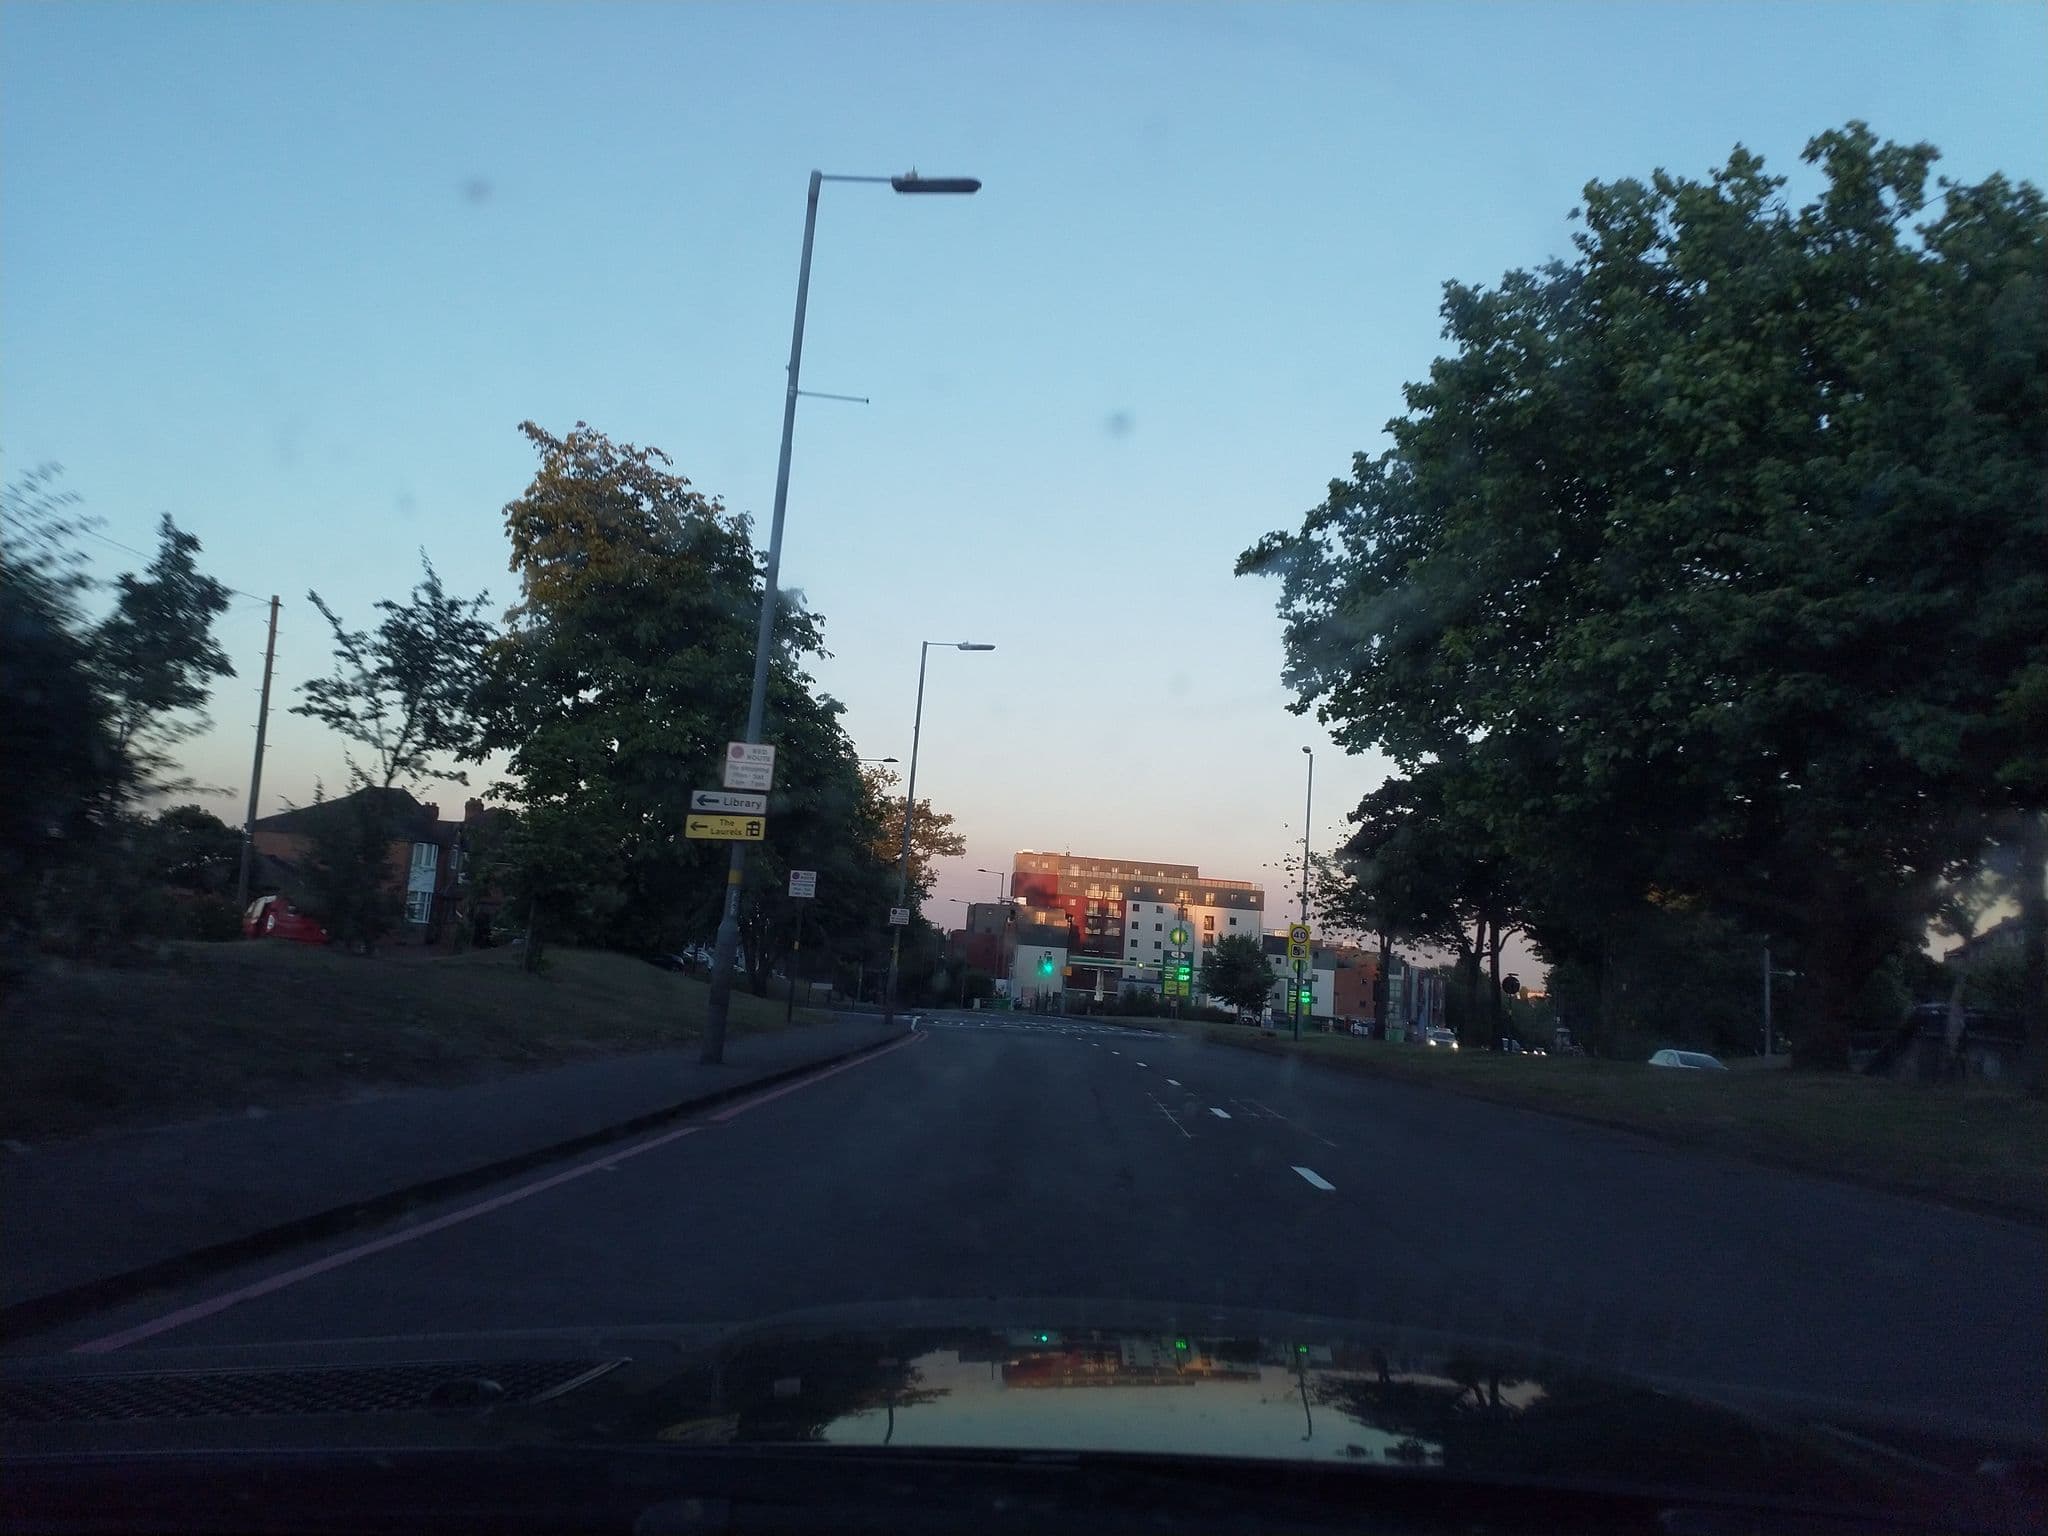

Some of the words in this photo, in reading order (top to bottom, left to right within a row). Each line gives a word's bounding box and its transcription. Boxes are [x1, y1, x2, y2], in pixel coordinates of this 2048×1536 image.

[723, 797, 761, 810] Library
[720, 819, 735, 827] The
[710, 828, 743, 836] Laurels
[1293, 930, 1306, 939] 40
